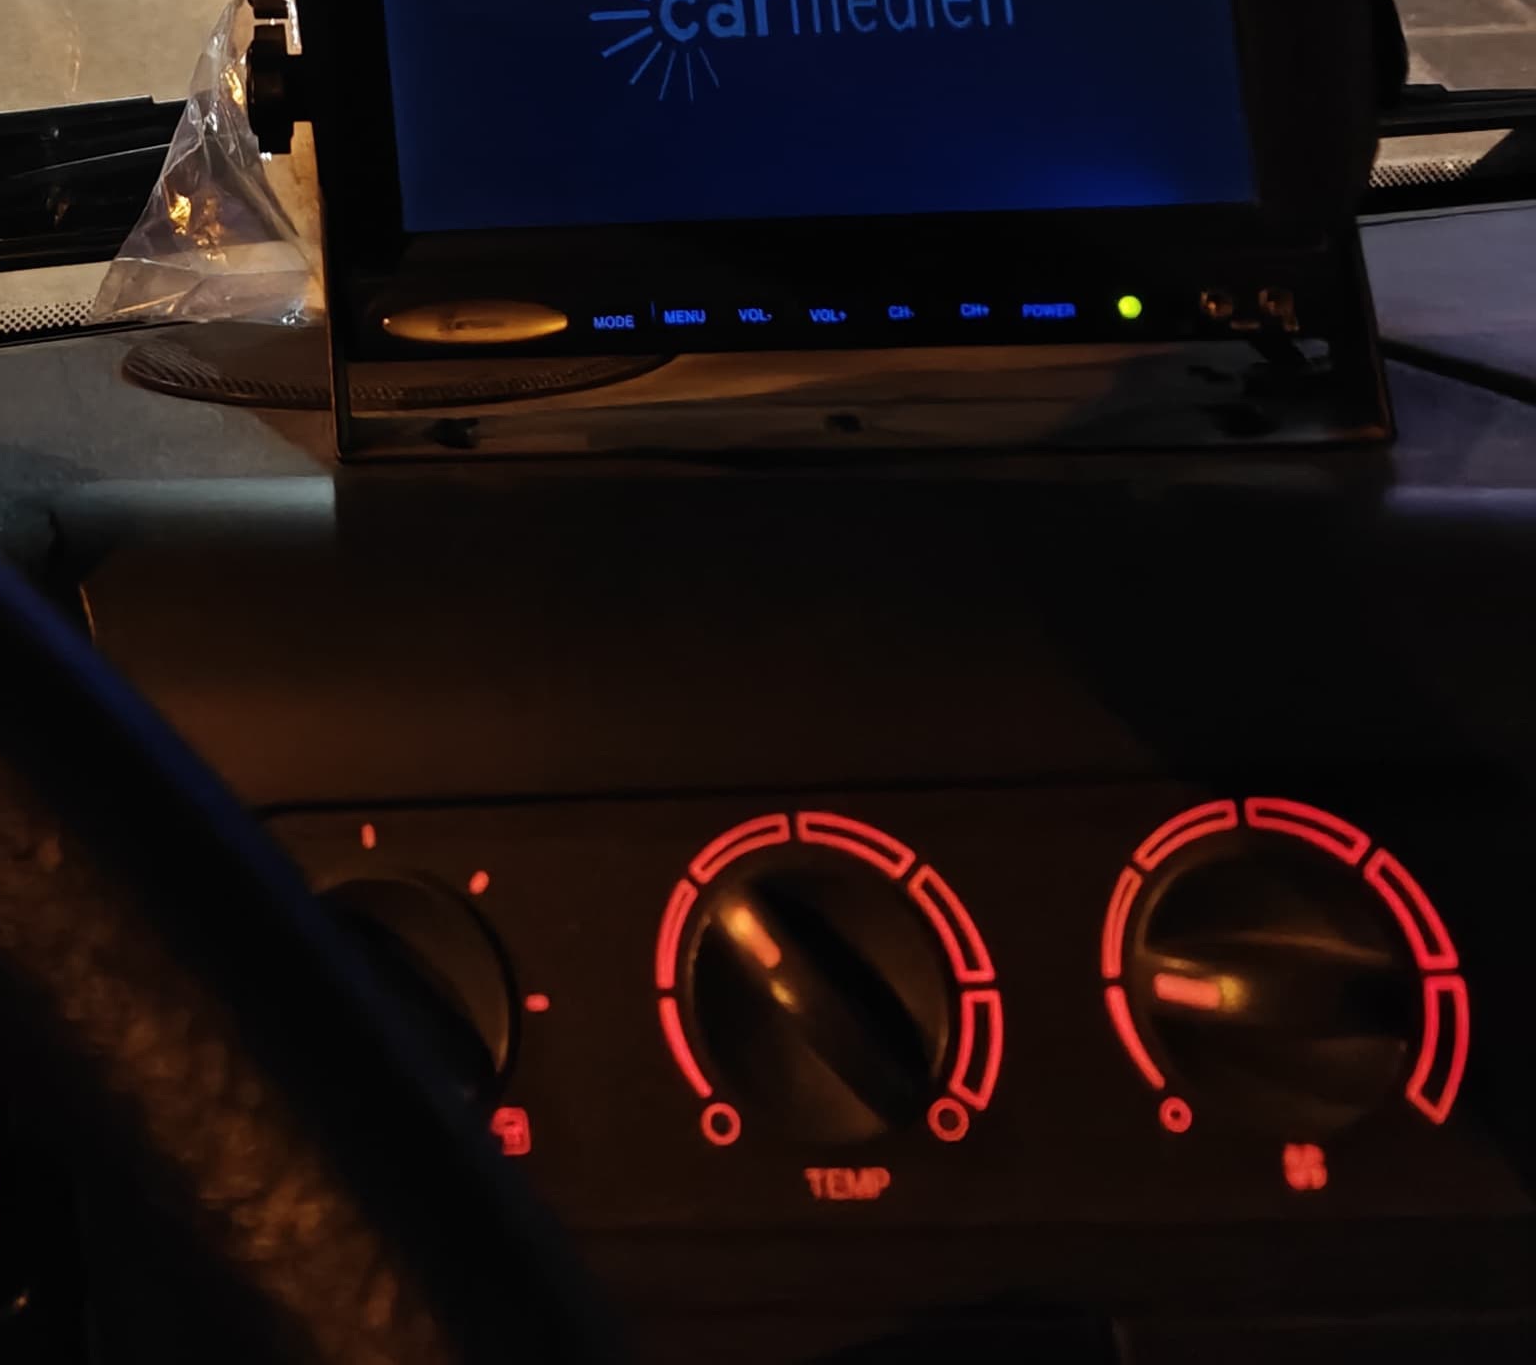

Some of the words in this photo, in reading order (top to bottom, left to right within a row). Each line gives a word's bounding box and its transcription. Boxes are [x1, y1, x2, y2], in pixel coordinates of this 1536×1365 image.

[663, 309, 707, 325] MENU
[809, 308, 848, 323] VOL+
[1021, 302, 1076, 319] POWER
[593, 314, 635, 330] MODE
[805, 1167, 891, 1200] TEMP
